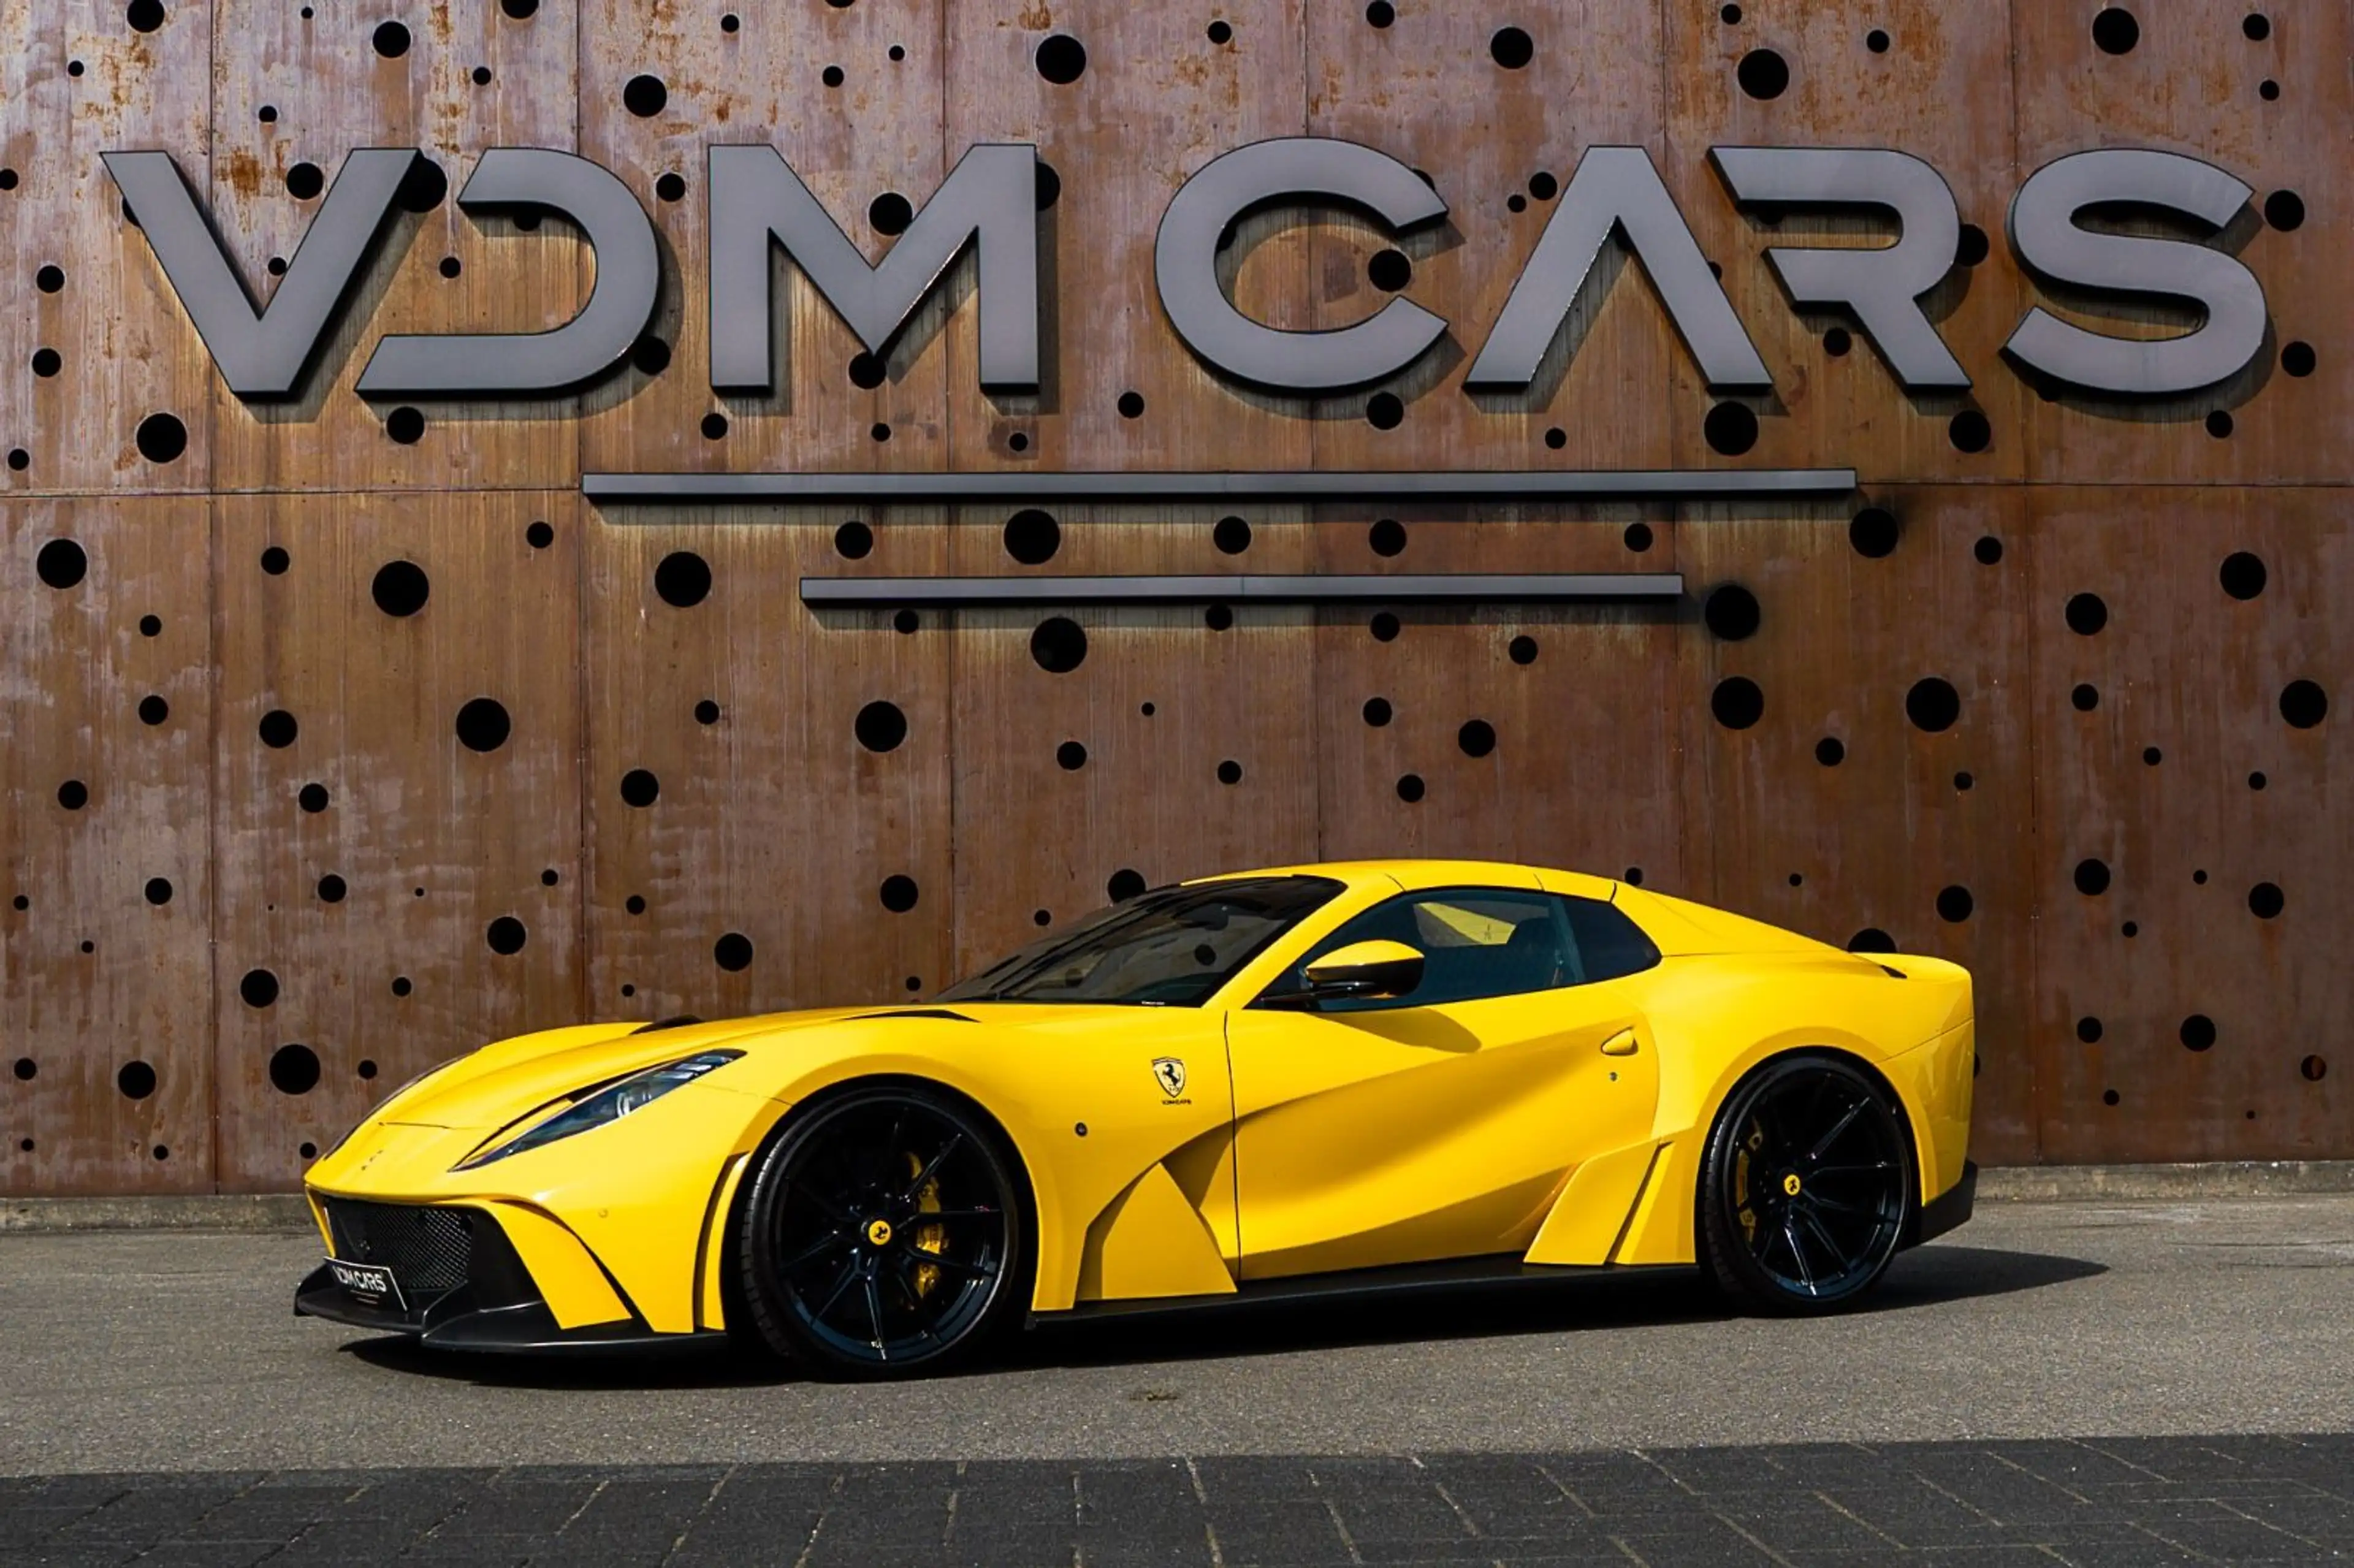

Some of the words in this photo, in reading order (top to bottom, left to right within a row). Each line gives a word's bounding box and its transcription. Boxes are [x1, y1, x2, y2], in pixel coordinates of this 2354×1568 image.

[100, 144, 1038, 396] VDM
[1155, 137, 2268, 394] CARS
[354, 1271, 387, 1292] CARS
